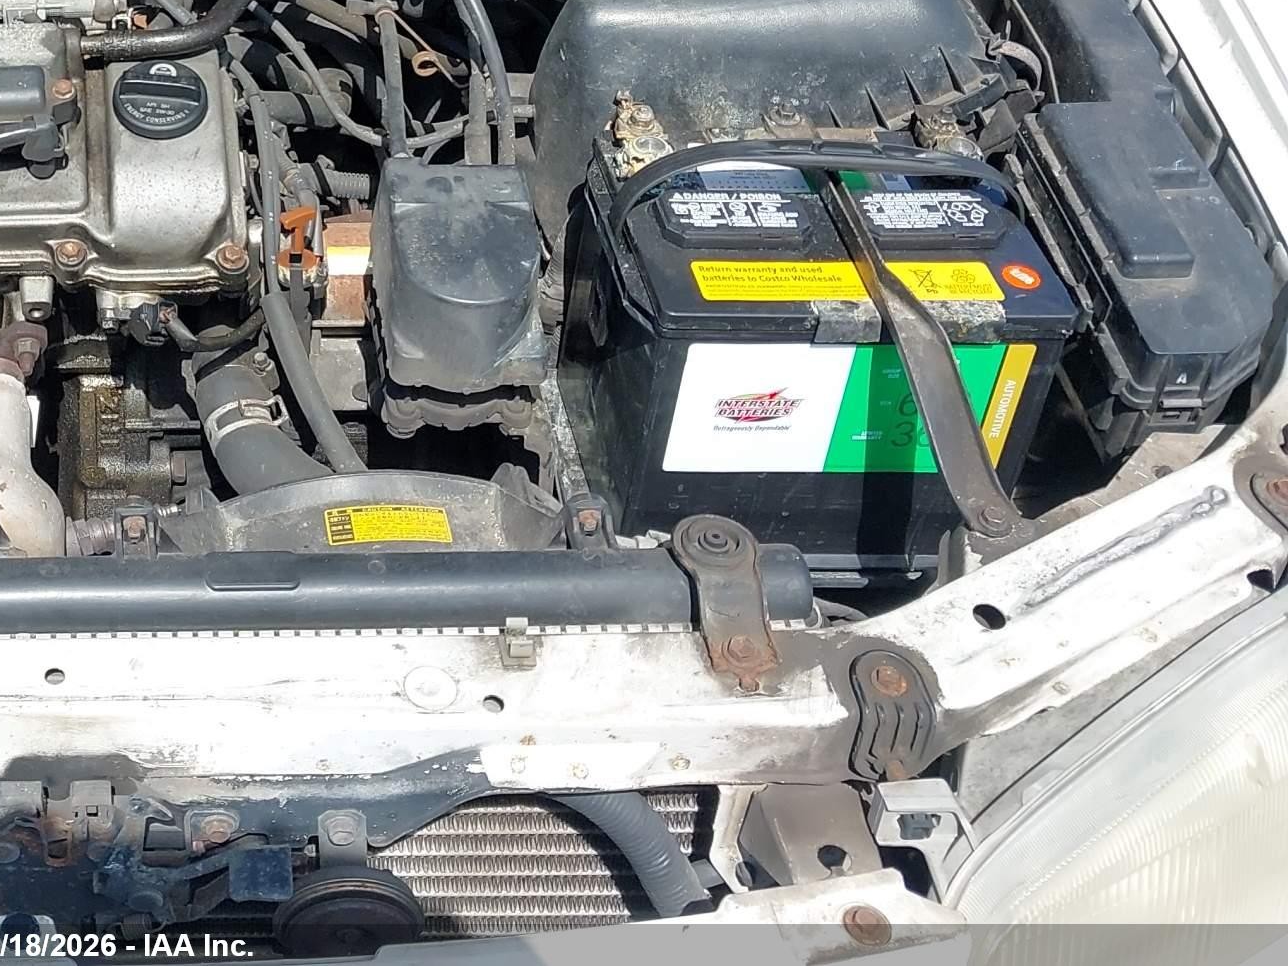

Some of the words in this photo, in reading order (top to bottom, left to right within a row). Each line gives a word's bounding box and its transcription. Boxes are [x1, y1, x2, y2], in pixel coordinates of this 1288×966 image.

[146, 111, 186, 124] CONSERVING
[683, 193, 730, 201] DANGER
[739, 193, 782, 201] POISON
[698, 265, 732, 273] Return
[733, 266, 778, 275] warranty
[779, 266, 798, 274] and
[799, 266, 823, 274] used
[702, 274, 746, 283] batteries
[747, 275, 758, 283] to
[759, 274, 791, 283] Costco
[792, 274, 843, 283] Wholesale
[717, 400, 800, 408] INTERSTATE
[717, 408, 792, 416] BATTERIES
[989, 379, 1017, 439] AUTOMOTIVE
